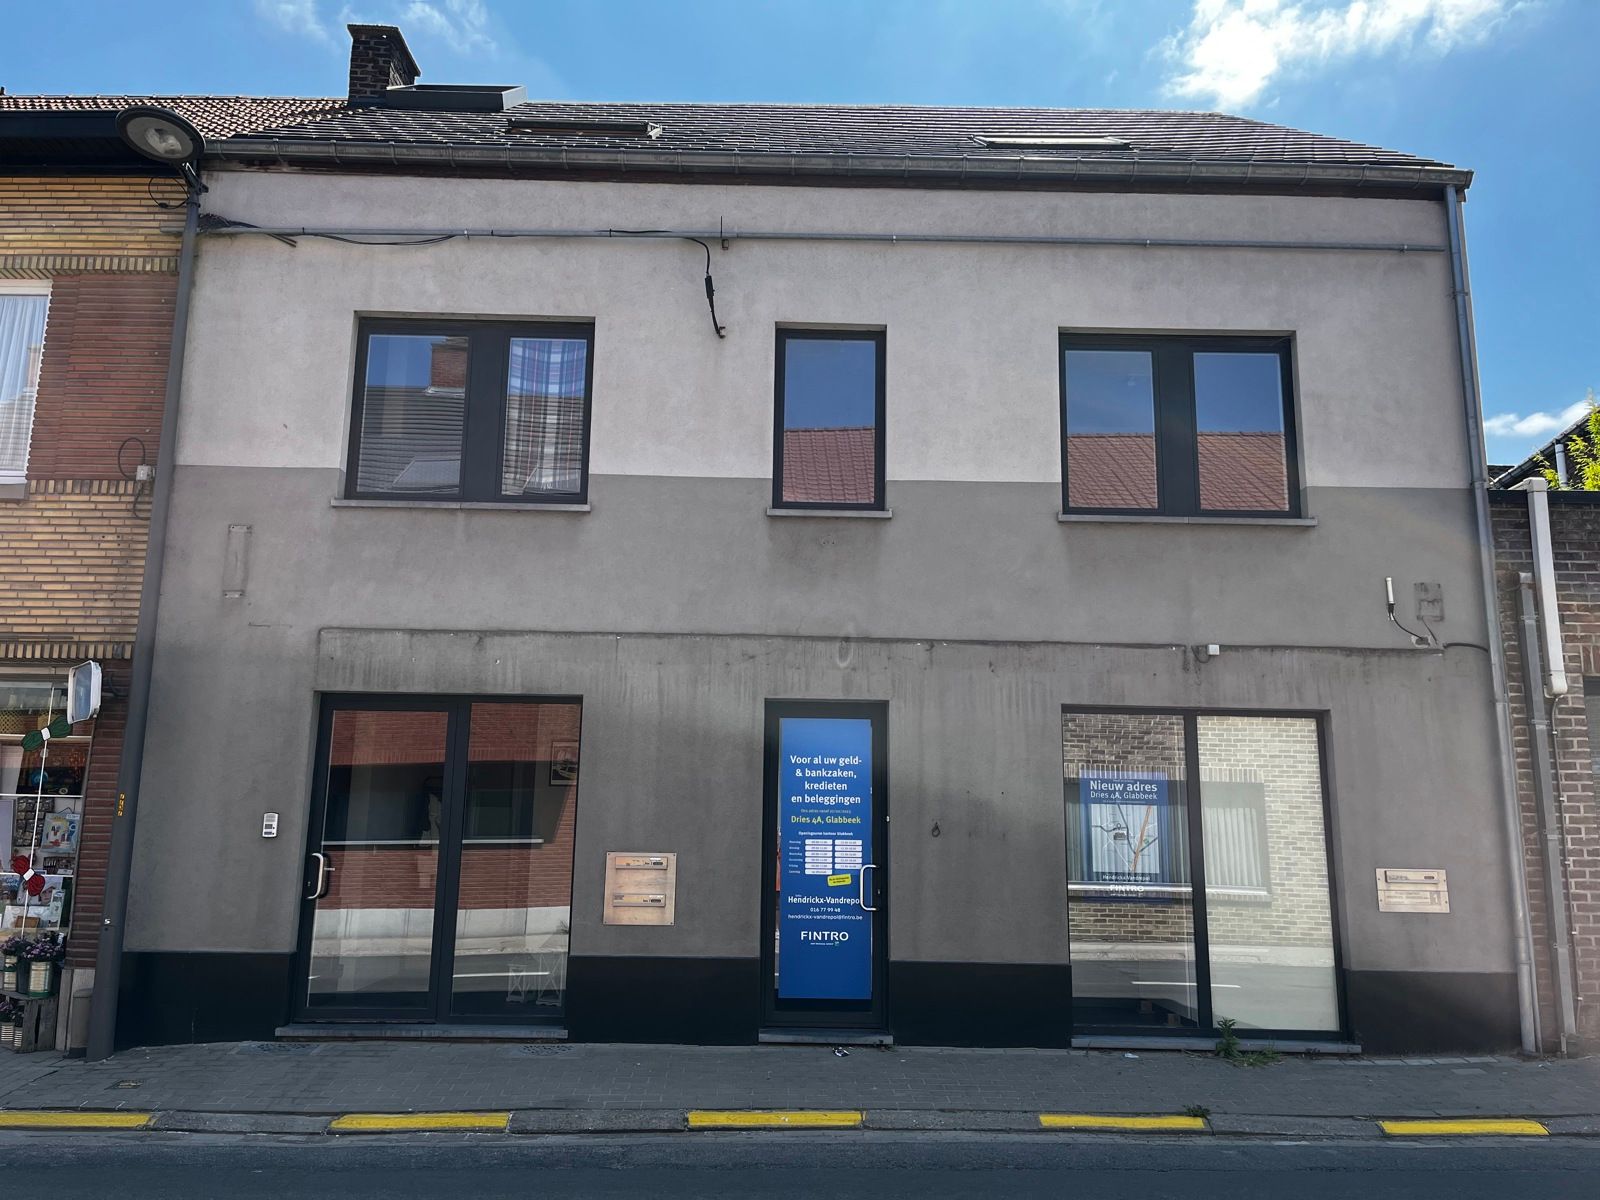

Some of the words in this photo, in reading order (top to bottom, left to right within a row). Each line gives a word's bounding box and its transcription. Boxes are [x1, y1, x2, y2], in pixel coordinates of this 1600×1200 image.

[790, 755, 811, 764] Voor
[813, 755, 821, 764] al
[839, 756, 862, 766] geld-
[795, 768, 803, 777] &
[805, 768, 856, 778] bankzaken,
[804, 781, 848, 791] kredieten
[1090, 780, 1124, 791] Nieuw
[1126, 781, 1158, 792] adres
[804, 794, 861, 805] beleggingen
[1090, 791, 1108, 799] Dries
[1123, 792, 1158, 800] Glabbeek
[791, 815, 810, 823] Dries
[826, 815, 861, 824] Glabbeek
[1110, 884, 1145, 892] FINTRO
[788, 896, 860, 906] Hendrickx-Vandrepo
[800, 931, 849, 941] FINTRO
